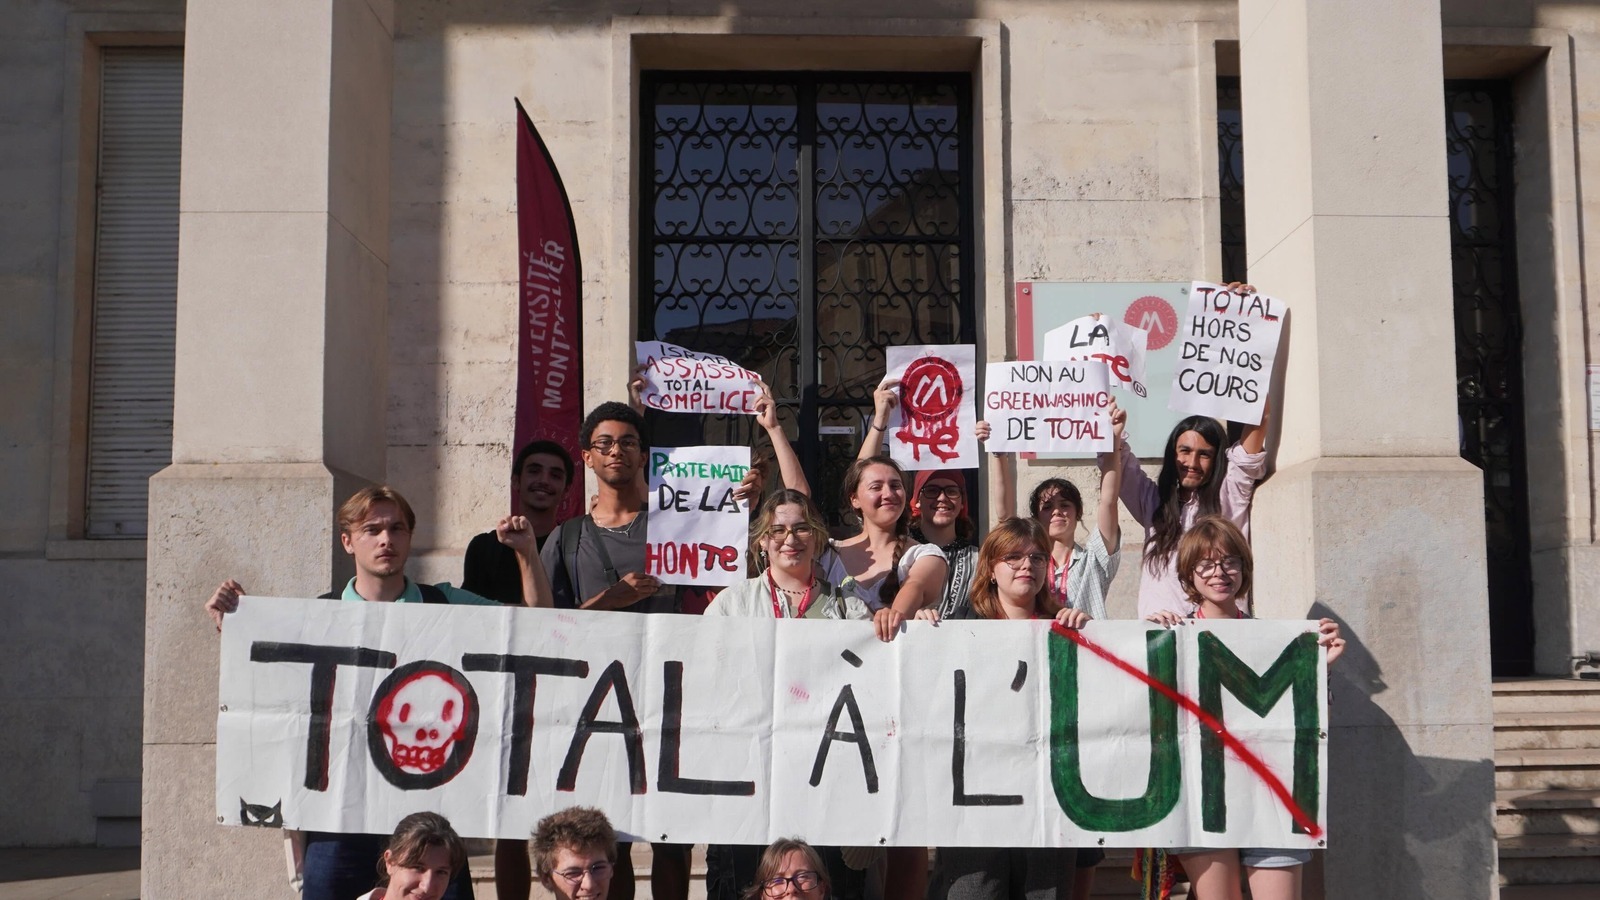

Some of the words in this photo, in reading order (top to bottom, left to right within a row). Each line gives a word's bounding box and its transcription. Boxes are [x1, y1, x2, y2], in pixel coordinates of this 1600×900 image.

[1196, 287, 1279, 323] TOTAL
[1069, 324, 1110, 349] LA
[1192, 315, 1252, 342] HORS
[1182, 341, 1210, 363] DE
[1219, 346, 1263, 372] NOS
[664, 379, 715, 391] TOTAL
[1011, 364, 1053, 383] NON
[1058, 366, 1085, 383] AU
[1178, 368, 1259, 404] COURS
[646, 391, 756, 413] COMPLICE
[987, 391, 1109, 410] GREENWASHING
[1007, 417, 1037, 440] DE
[1044, 417, 1105, 440] TOTAL
[658, 484, 691, 513] DE
[698, 486, 741, 514] LA
[250, 641, 756, 797] TOTAL
[809, 648, 879, 793] À
